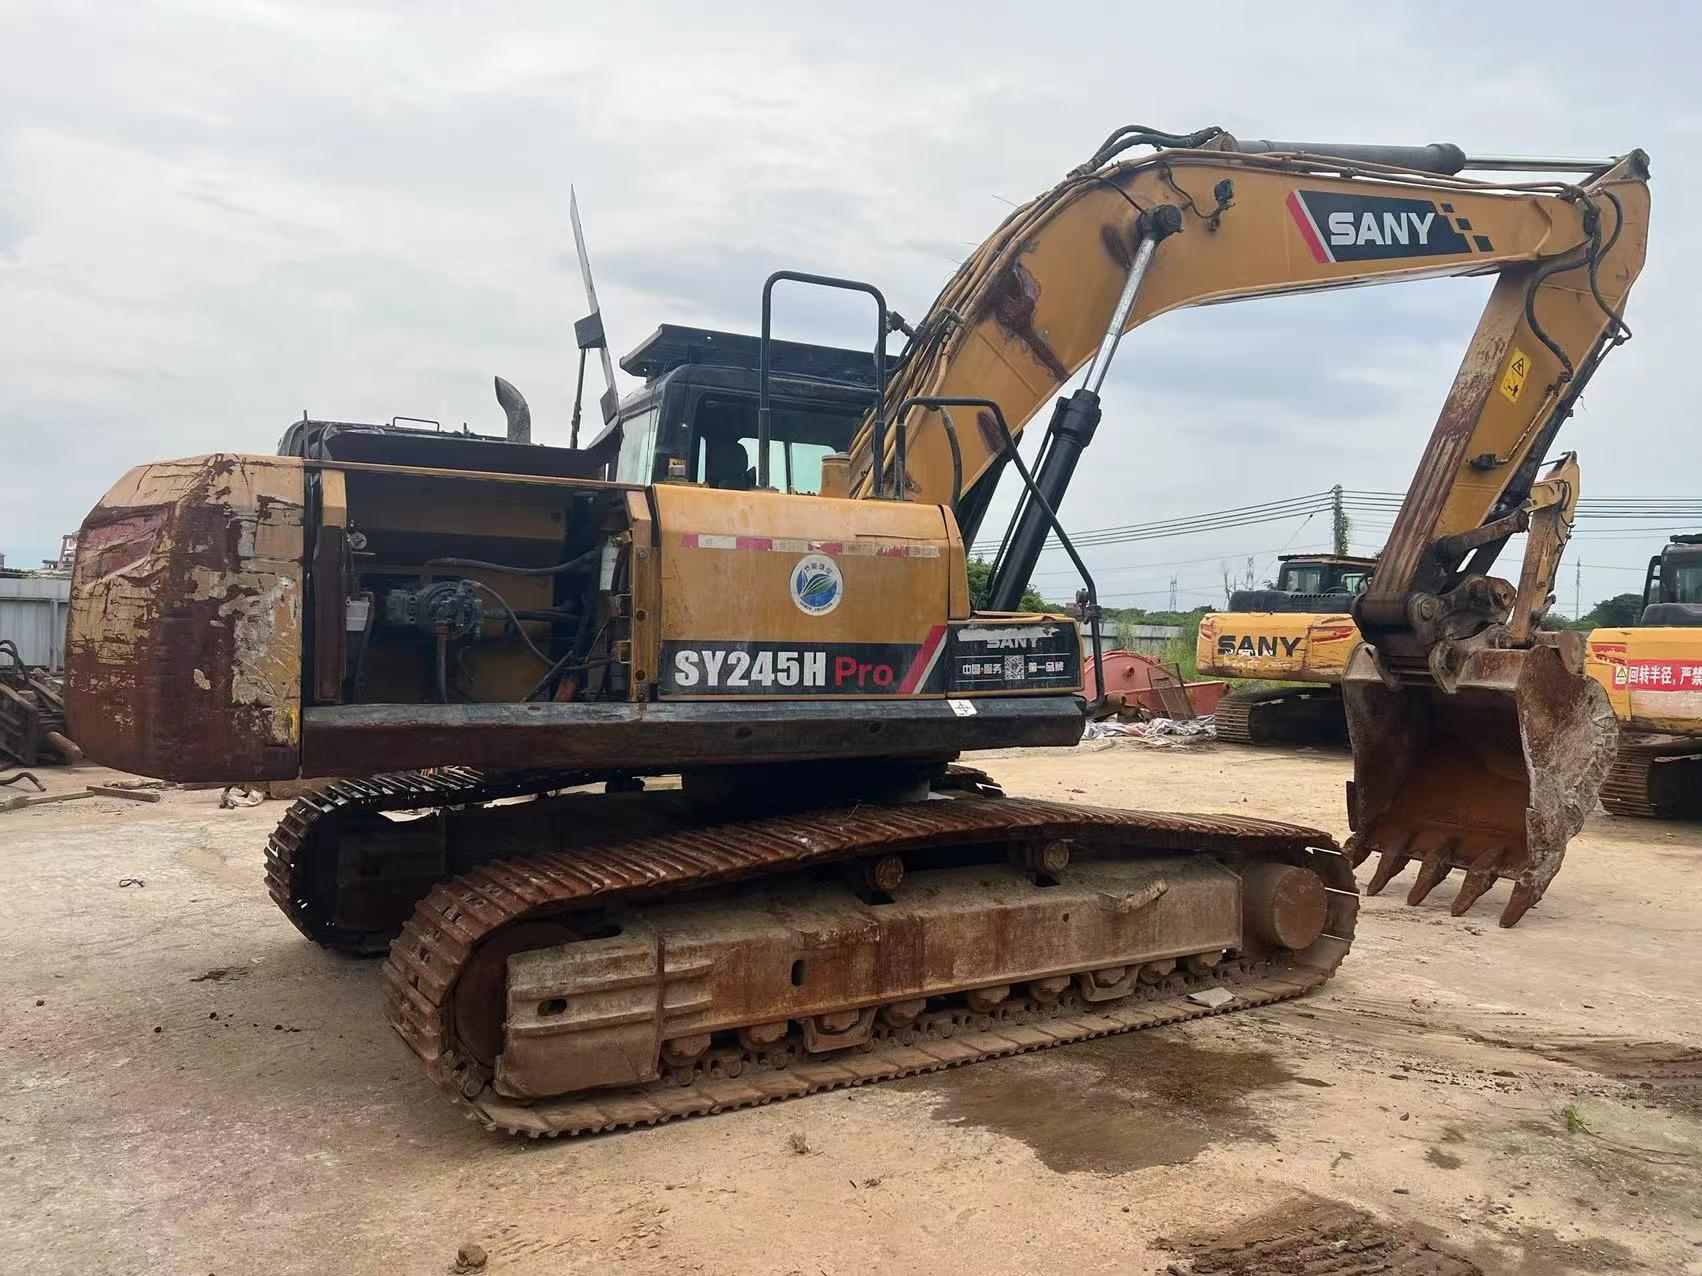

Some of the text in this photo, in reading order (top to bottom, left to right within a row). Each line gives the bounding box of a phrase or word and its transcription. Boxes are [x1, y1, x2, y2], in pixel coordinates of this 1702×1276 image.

[1328, 212, 1435, 246] SANY
[1218, 635, 1301, 657] SANY
[674, 650, 893, 687] SY245H Pro
